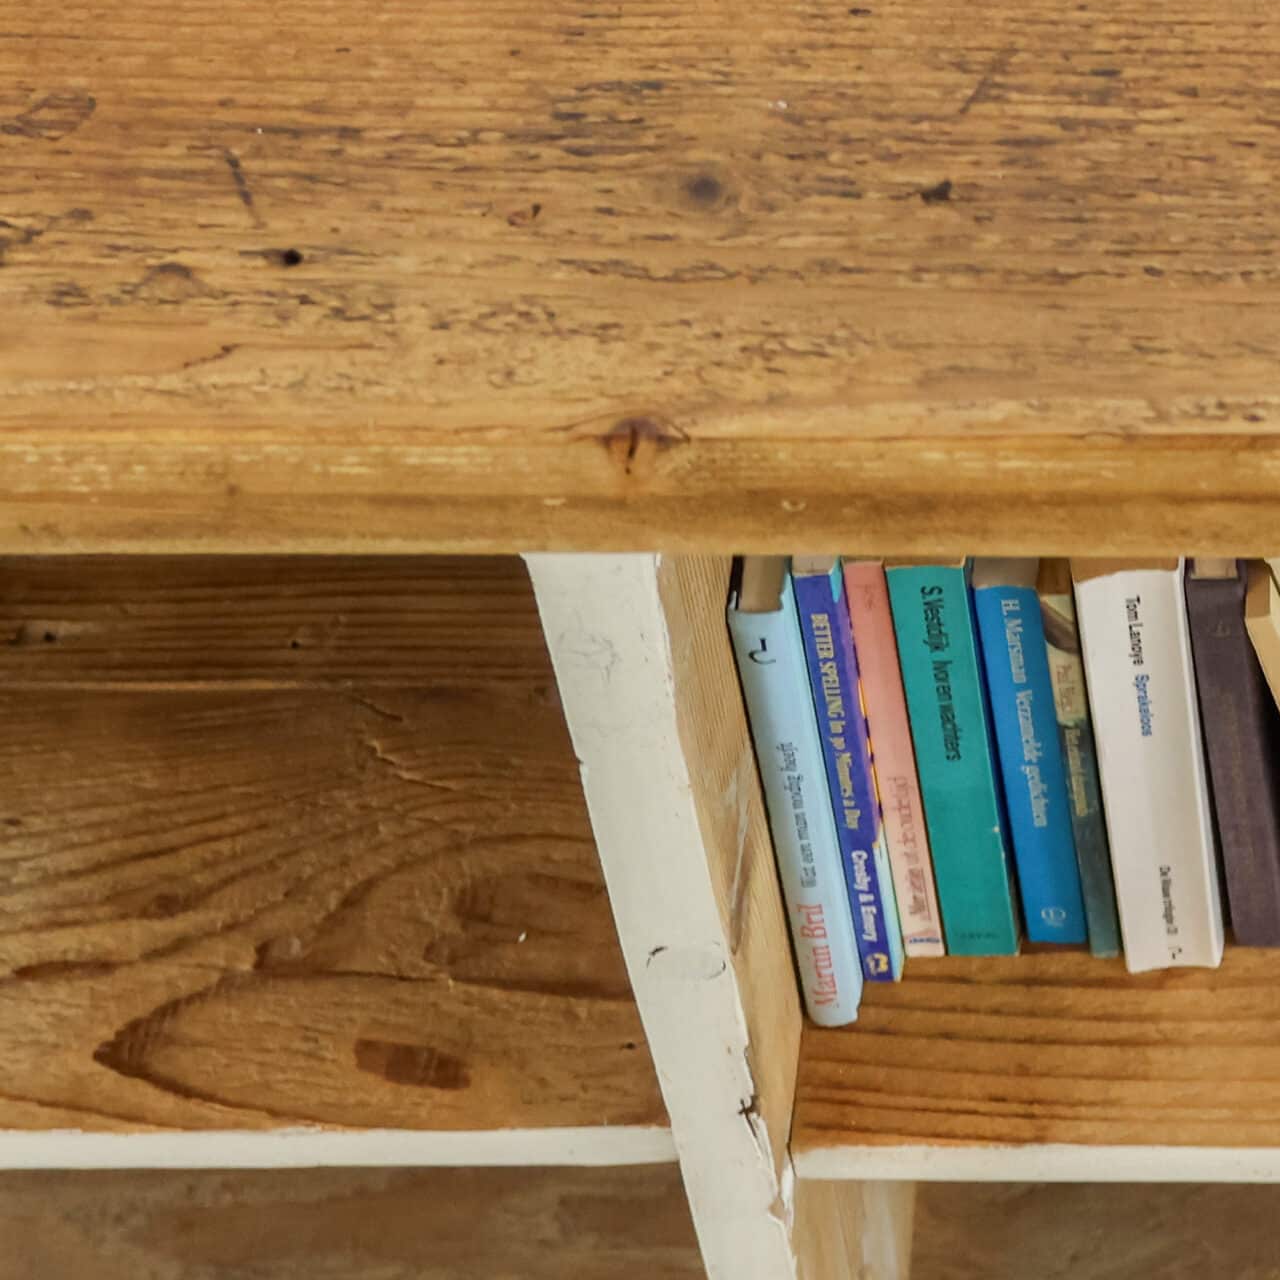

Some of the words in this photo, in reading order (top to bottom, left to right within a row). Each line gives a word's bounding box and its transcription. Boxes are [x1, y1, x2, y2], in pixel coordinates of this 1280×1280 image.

[1001, 599, 1021, 617] H.
[1125, 594, 1142, 621] Tom
[811, 613, 835, 660] BETTER
[1005, 618, 1027, 685] Marsman
[1128, 622, 1145, 667] Lanoye
[819, 661, 846, 719] SPELLING
[1132, 674, 1154, 738] Sprakeloos
[1016, 689, 1043, 763] Verzamelde
[851, 849, 871, 892] Crosby
[797, 903, 827, 939] Bril
[860, 904, 878, 942] Emery
